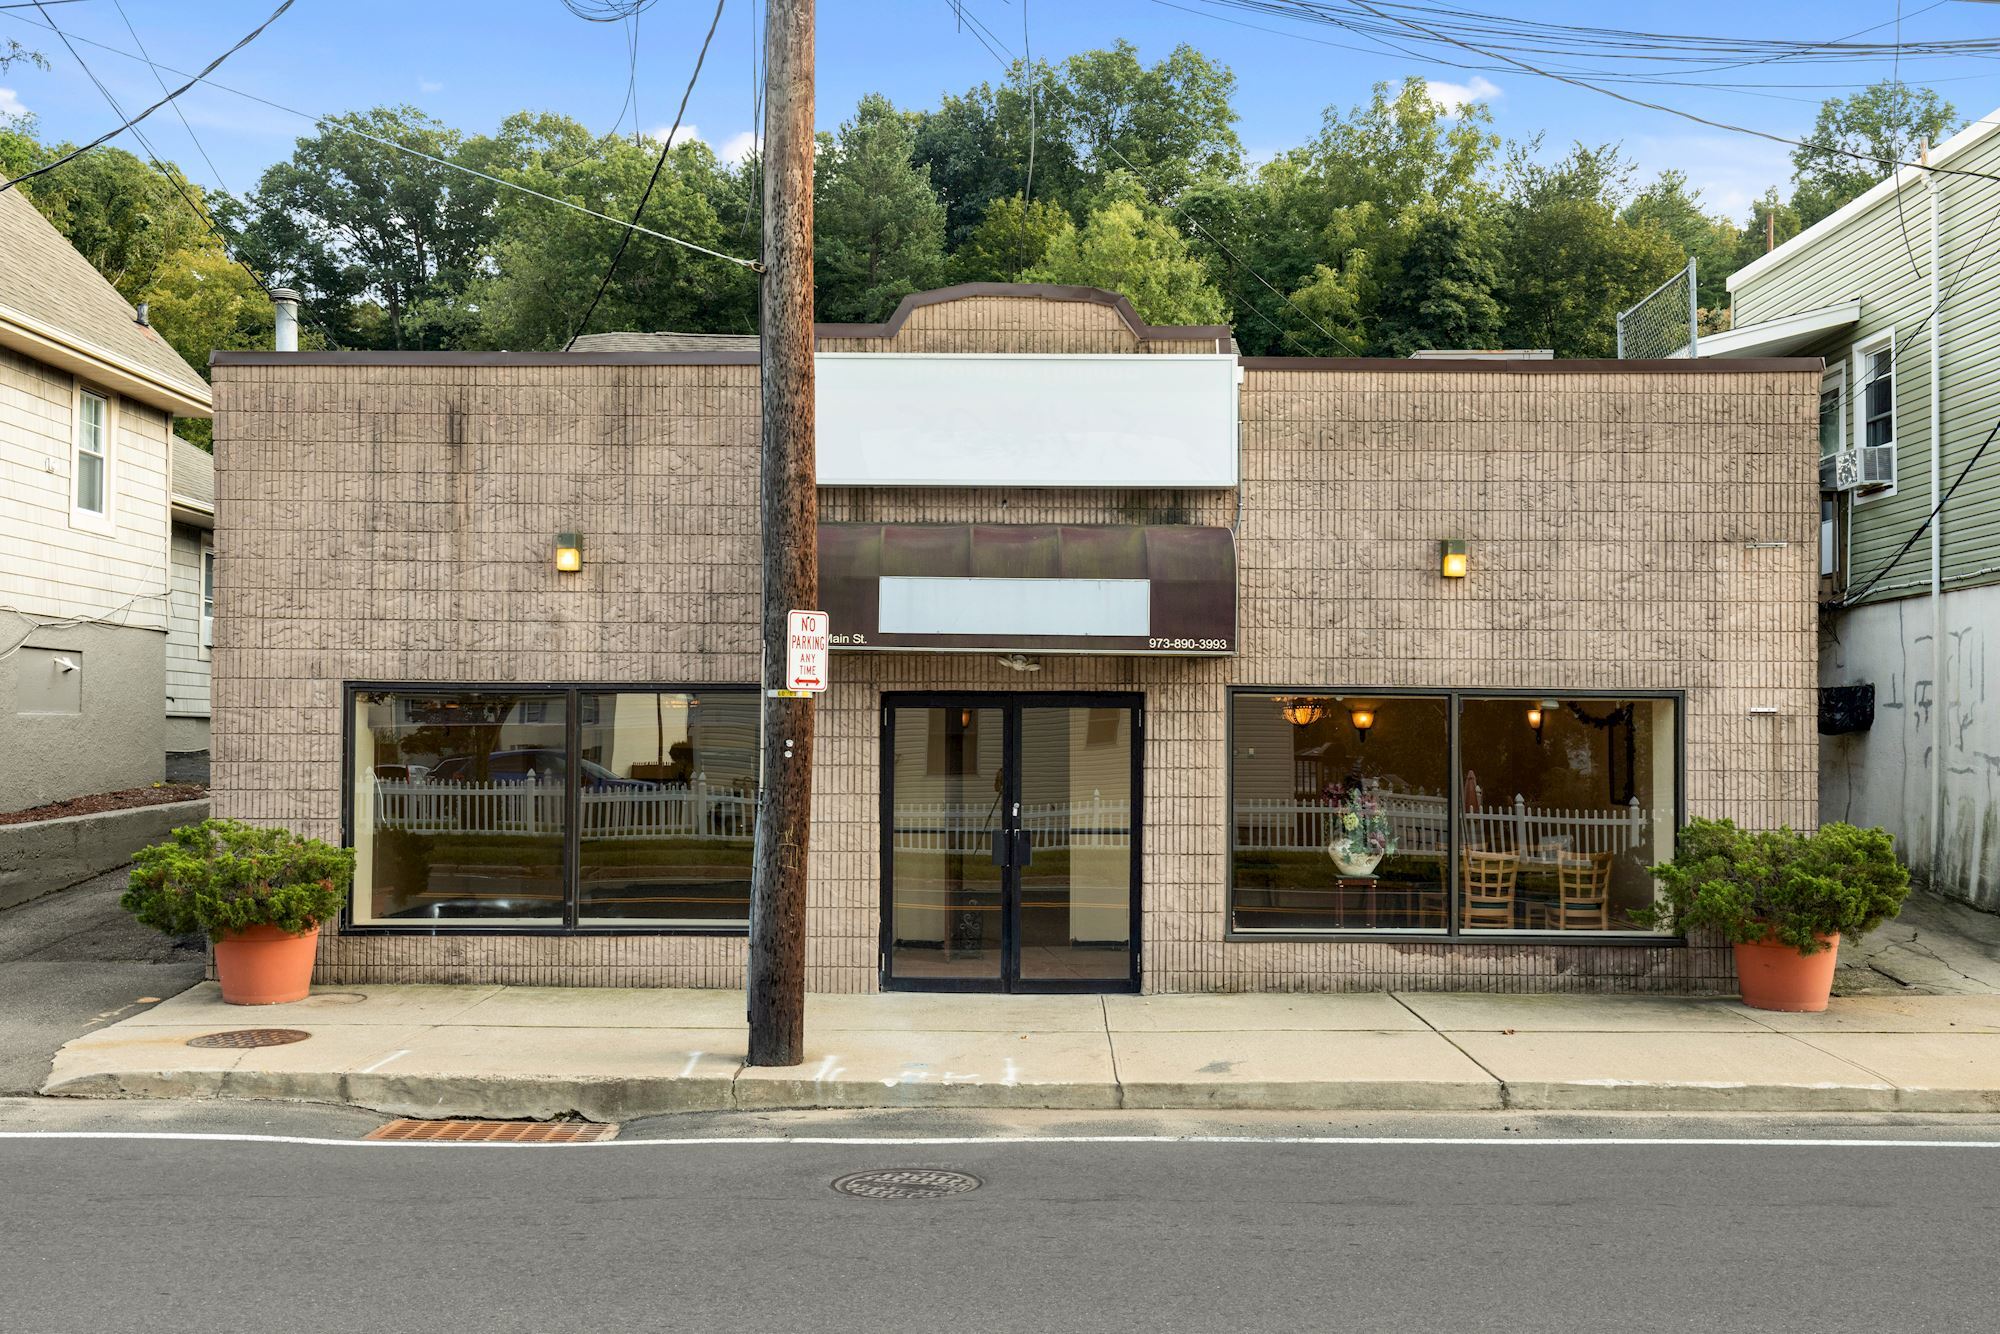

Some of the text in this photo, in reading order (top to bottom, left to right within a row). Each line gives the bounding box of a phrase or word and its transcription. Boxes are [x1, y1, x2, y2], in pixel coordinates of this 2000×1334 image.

[801, 617, 816, 632] NO
[791, 634, 825, 651] PARKING
[852, 633, 868, 644] St.
[1149, 638, 1227, 650] 973-890-3993
[800, 653, 816, 664] ANY
[800, 665, 817, 676] TIME
